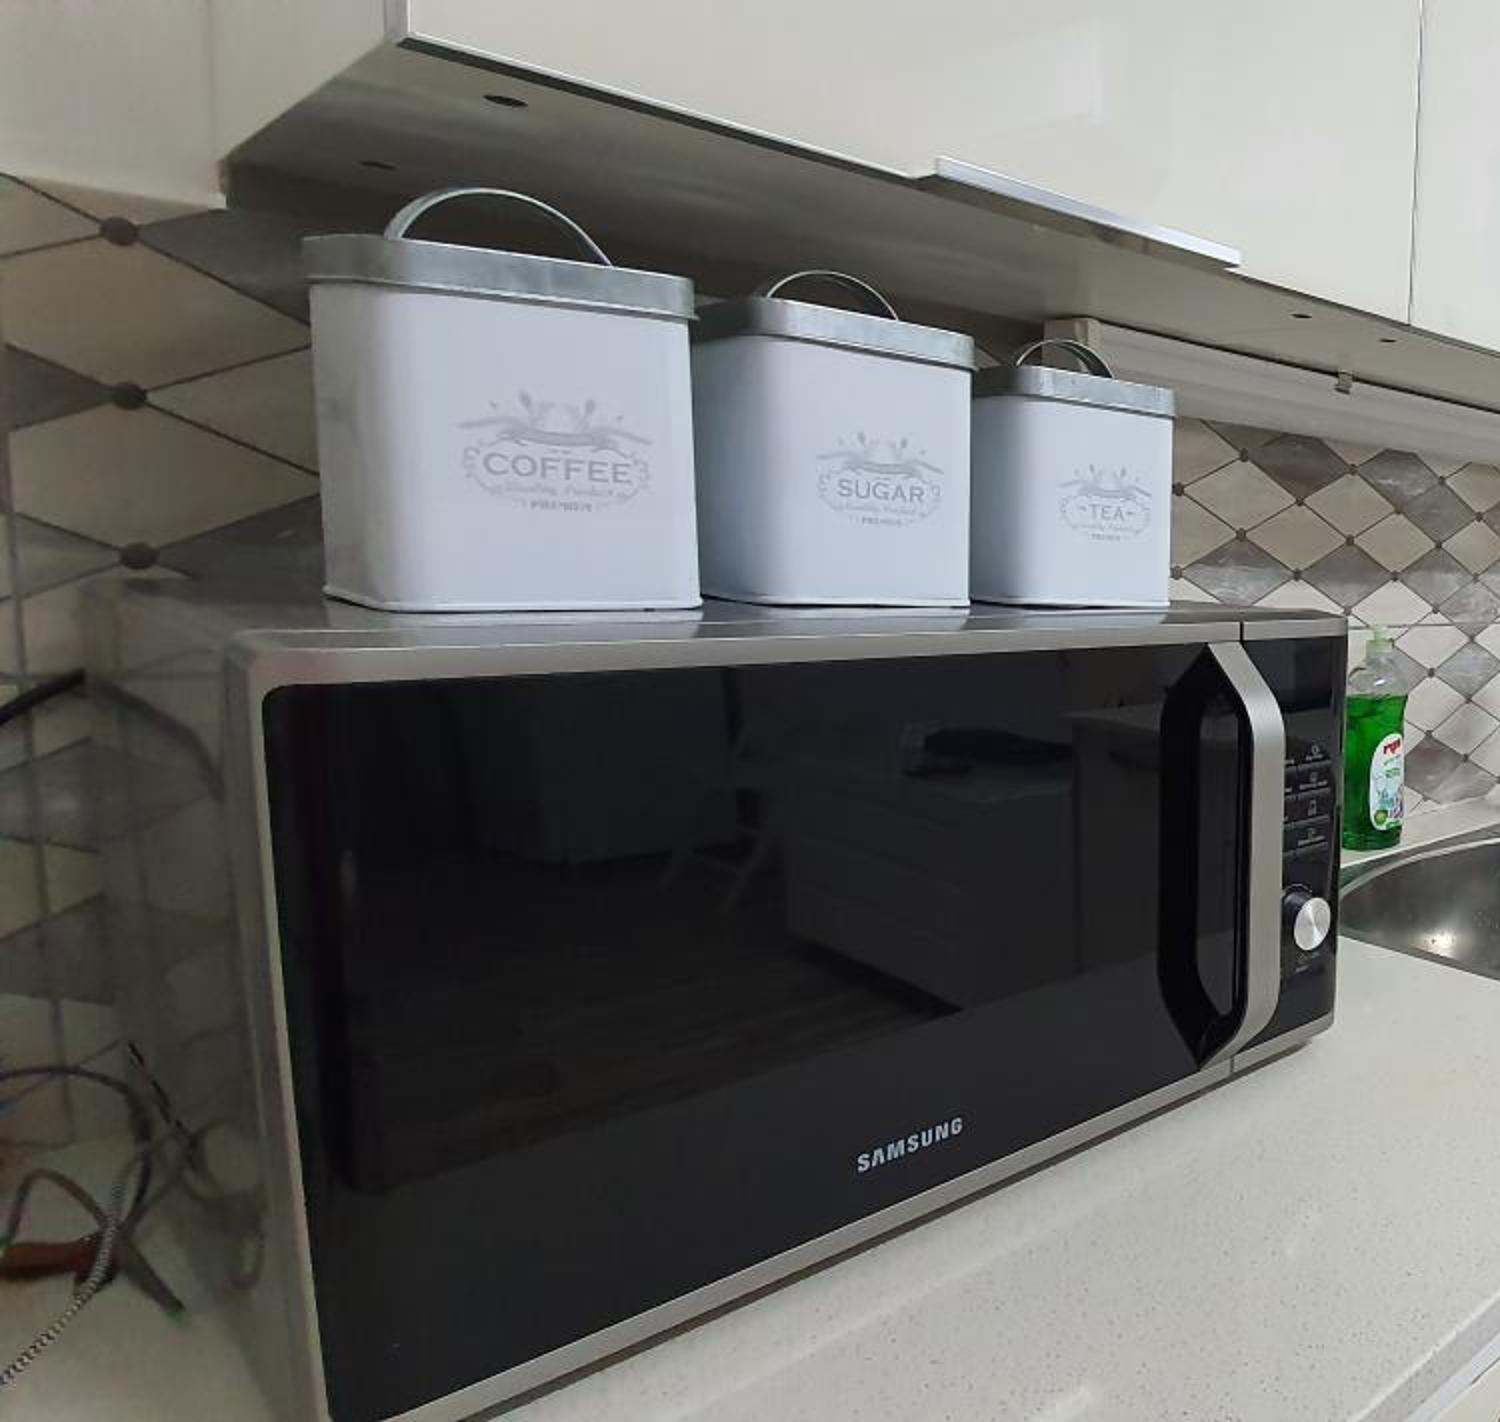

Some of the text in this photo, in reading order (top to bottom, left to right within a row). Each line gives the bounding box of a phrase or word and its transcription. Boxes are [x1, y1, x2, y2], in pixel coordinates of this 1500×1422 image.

[482, 452, 634, 484] COFFEE
[837, 478, 926, 503] SUGAR
[857, 1117, 963, 1173] SAMSUNG
